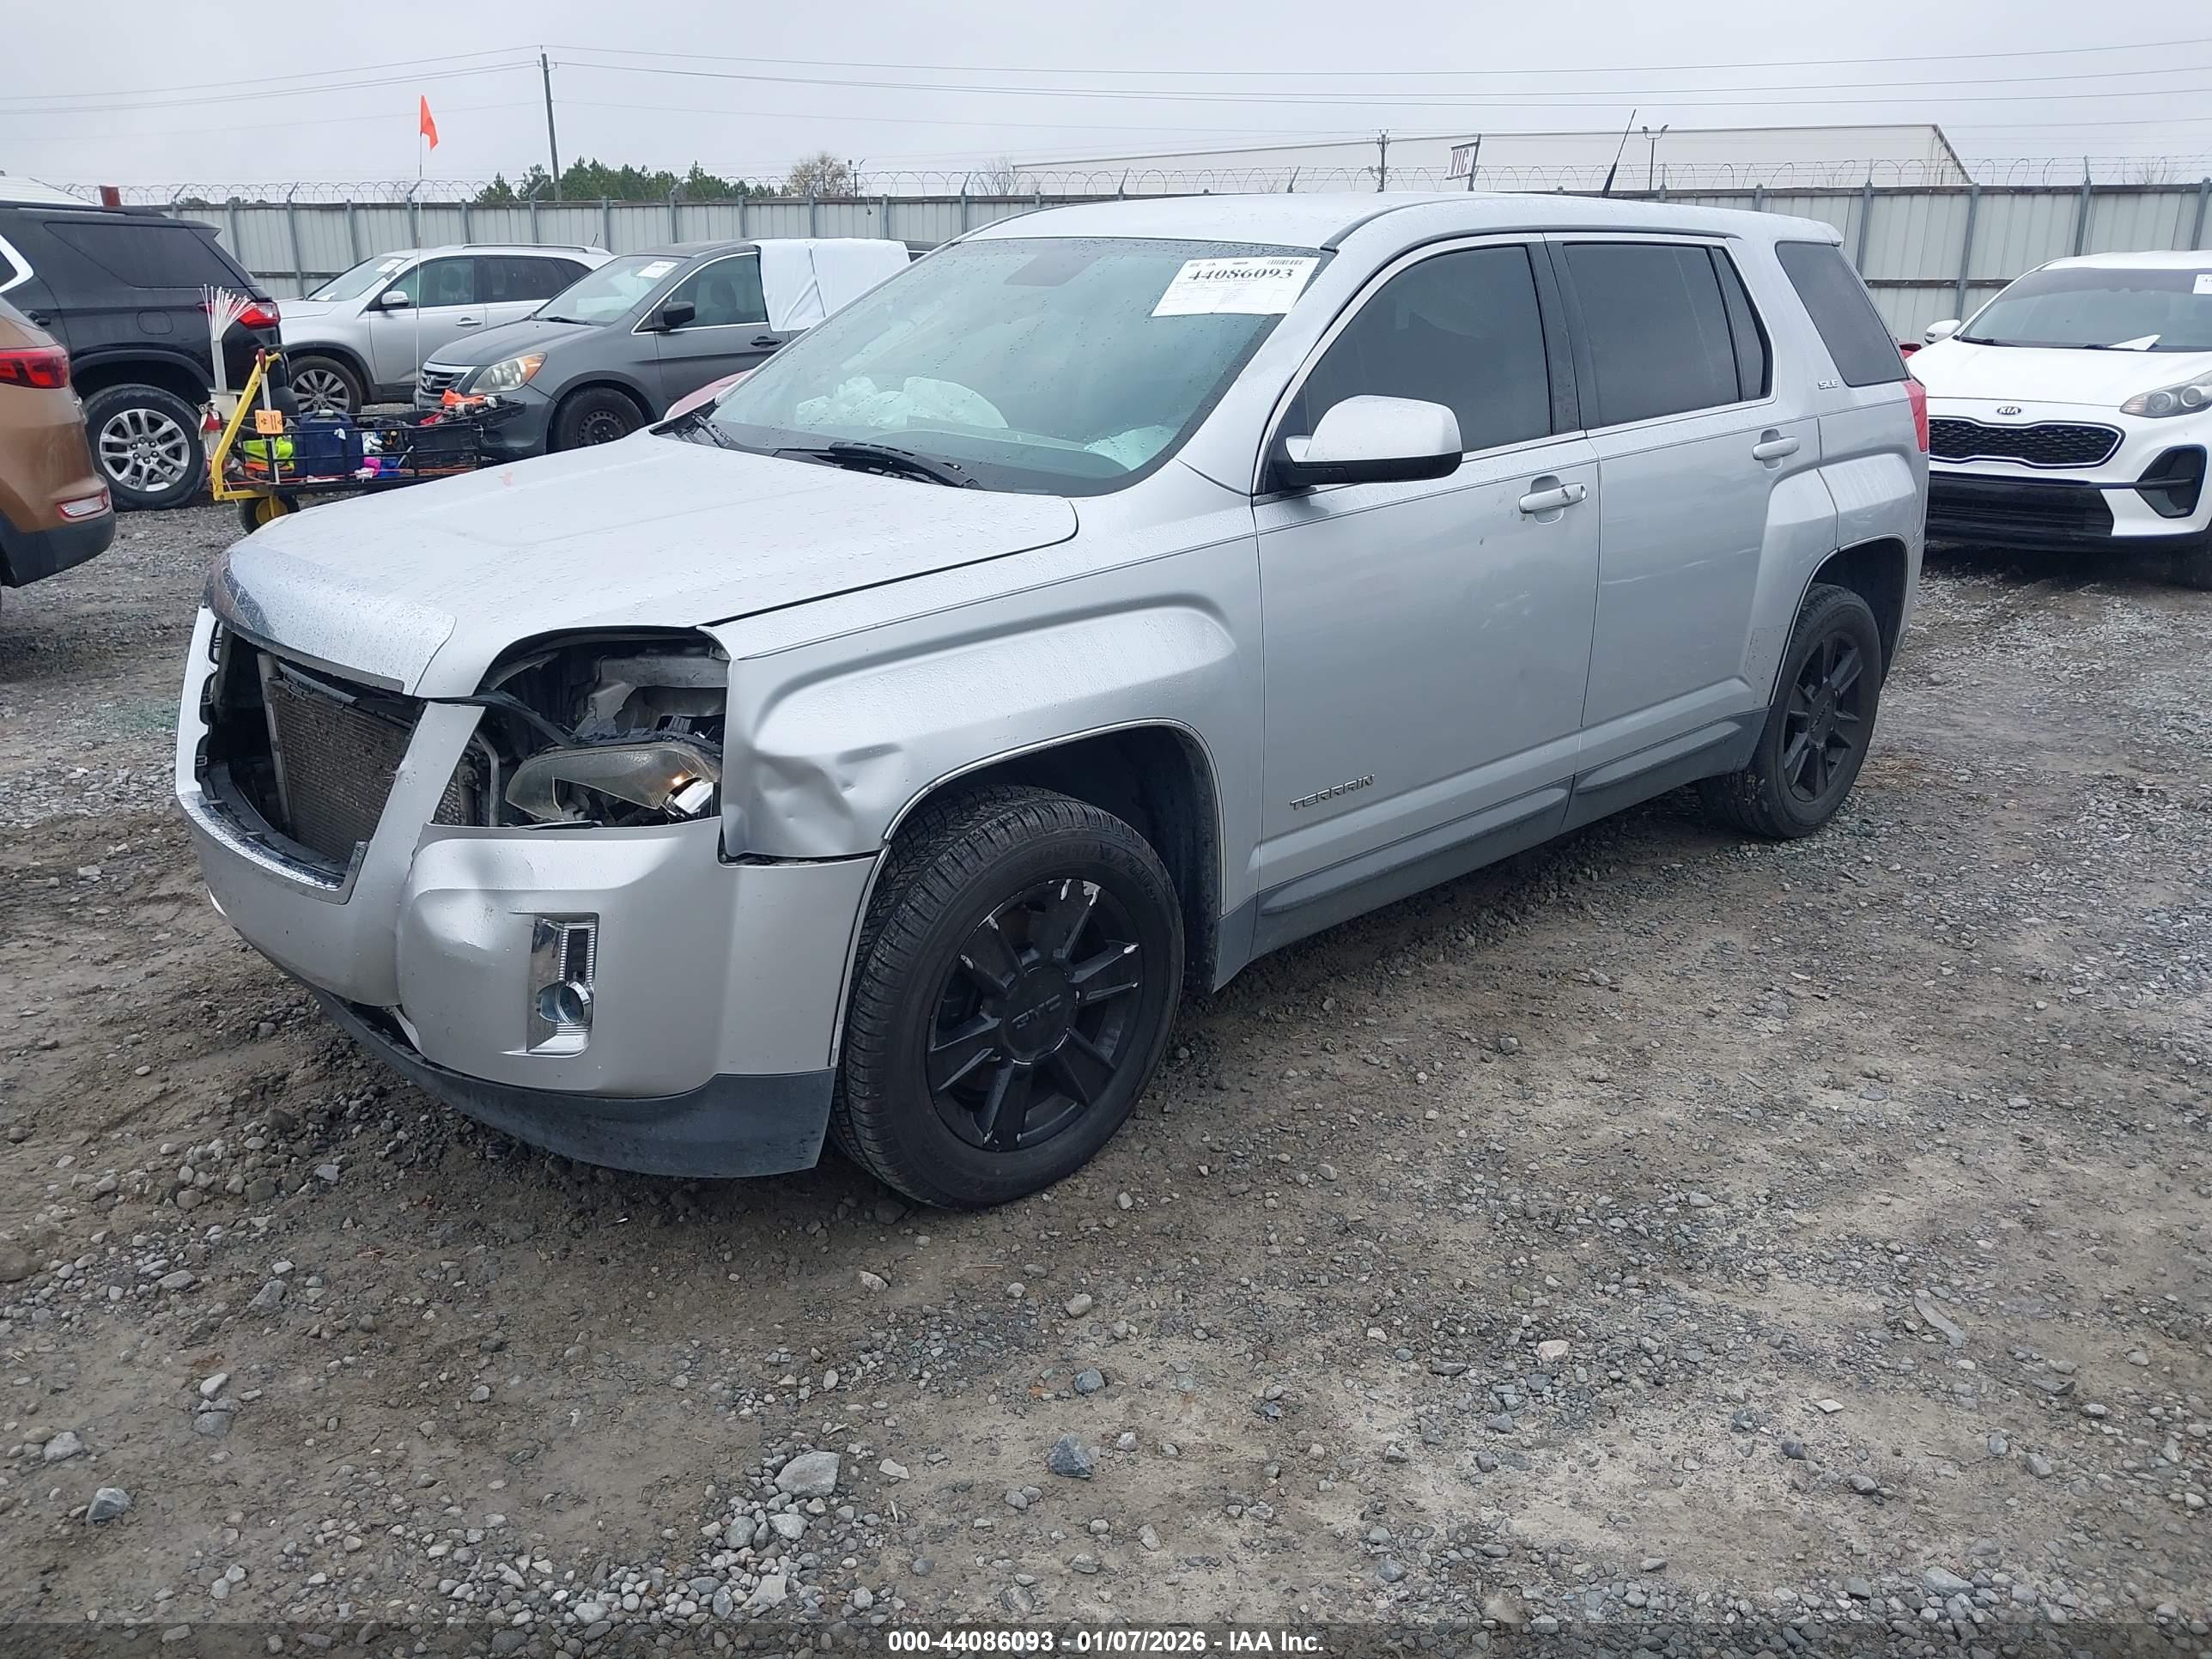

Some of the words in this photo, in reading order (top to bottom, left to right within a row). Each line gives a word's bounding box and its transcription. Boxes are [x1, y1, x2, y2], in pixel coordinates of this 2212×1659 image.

[1188, 268, 1295, 281] 44086093
[1817, 380, 1840, 390] SLE
[1998, 406, 2020, 415] KIA
[1290, 774, 1375, 811] TERRAIN
[1012, 994, 1062, 1030] GMC
